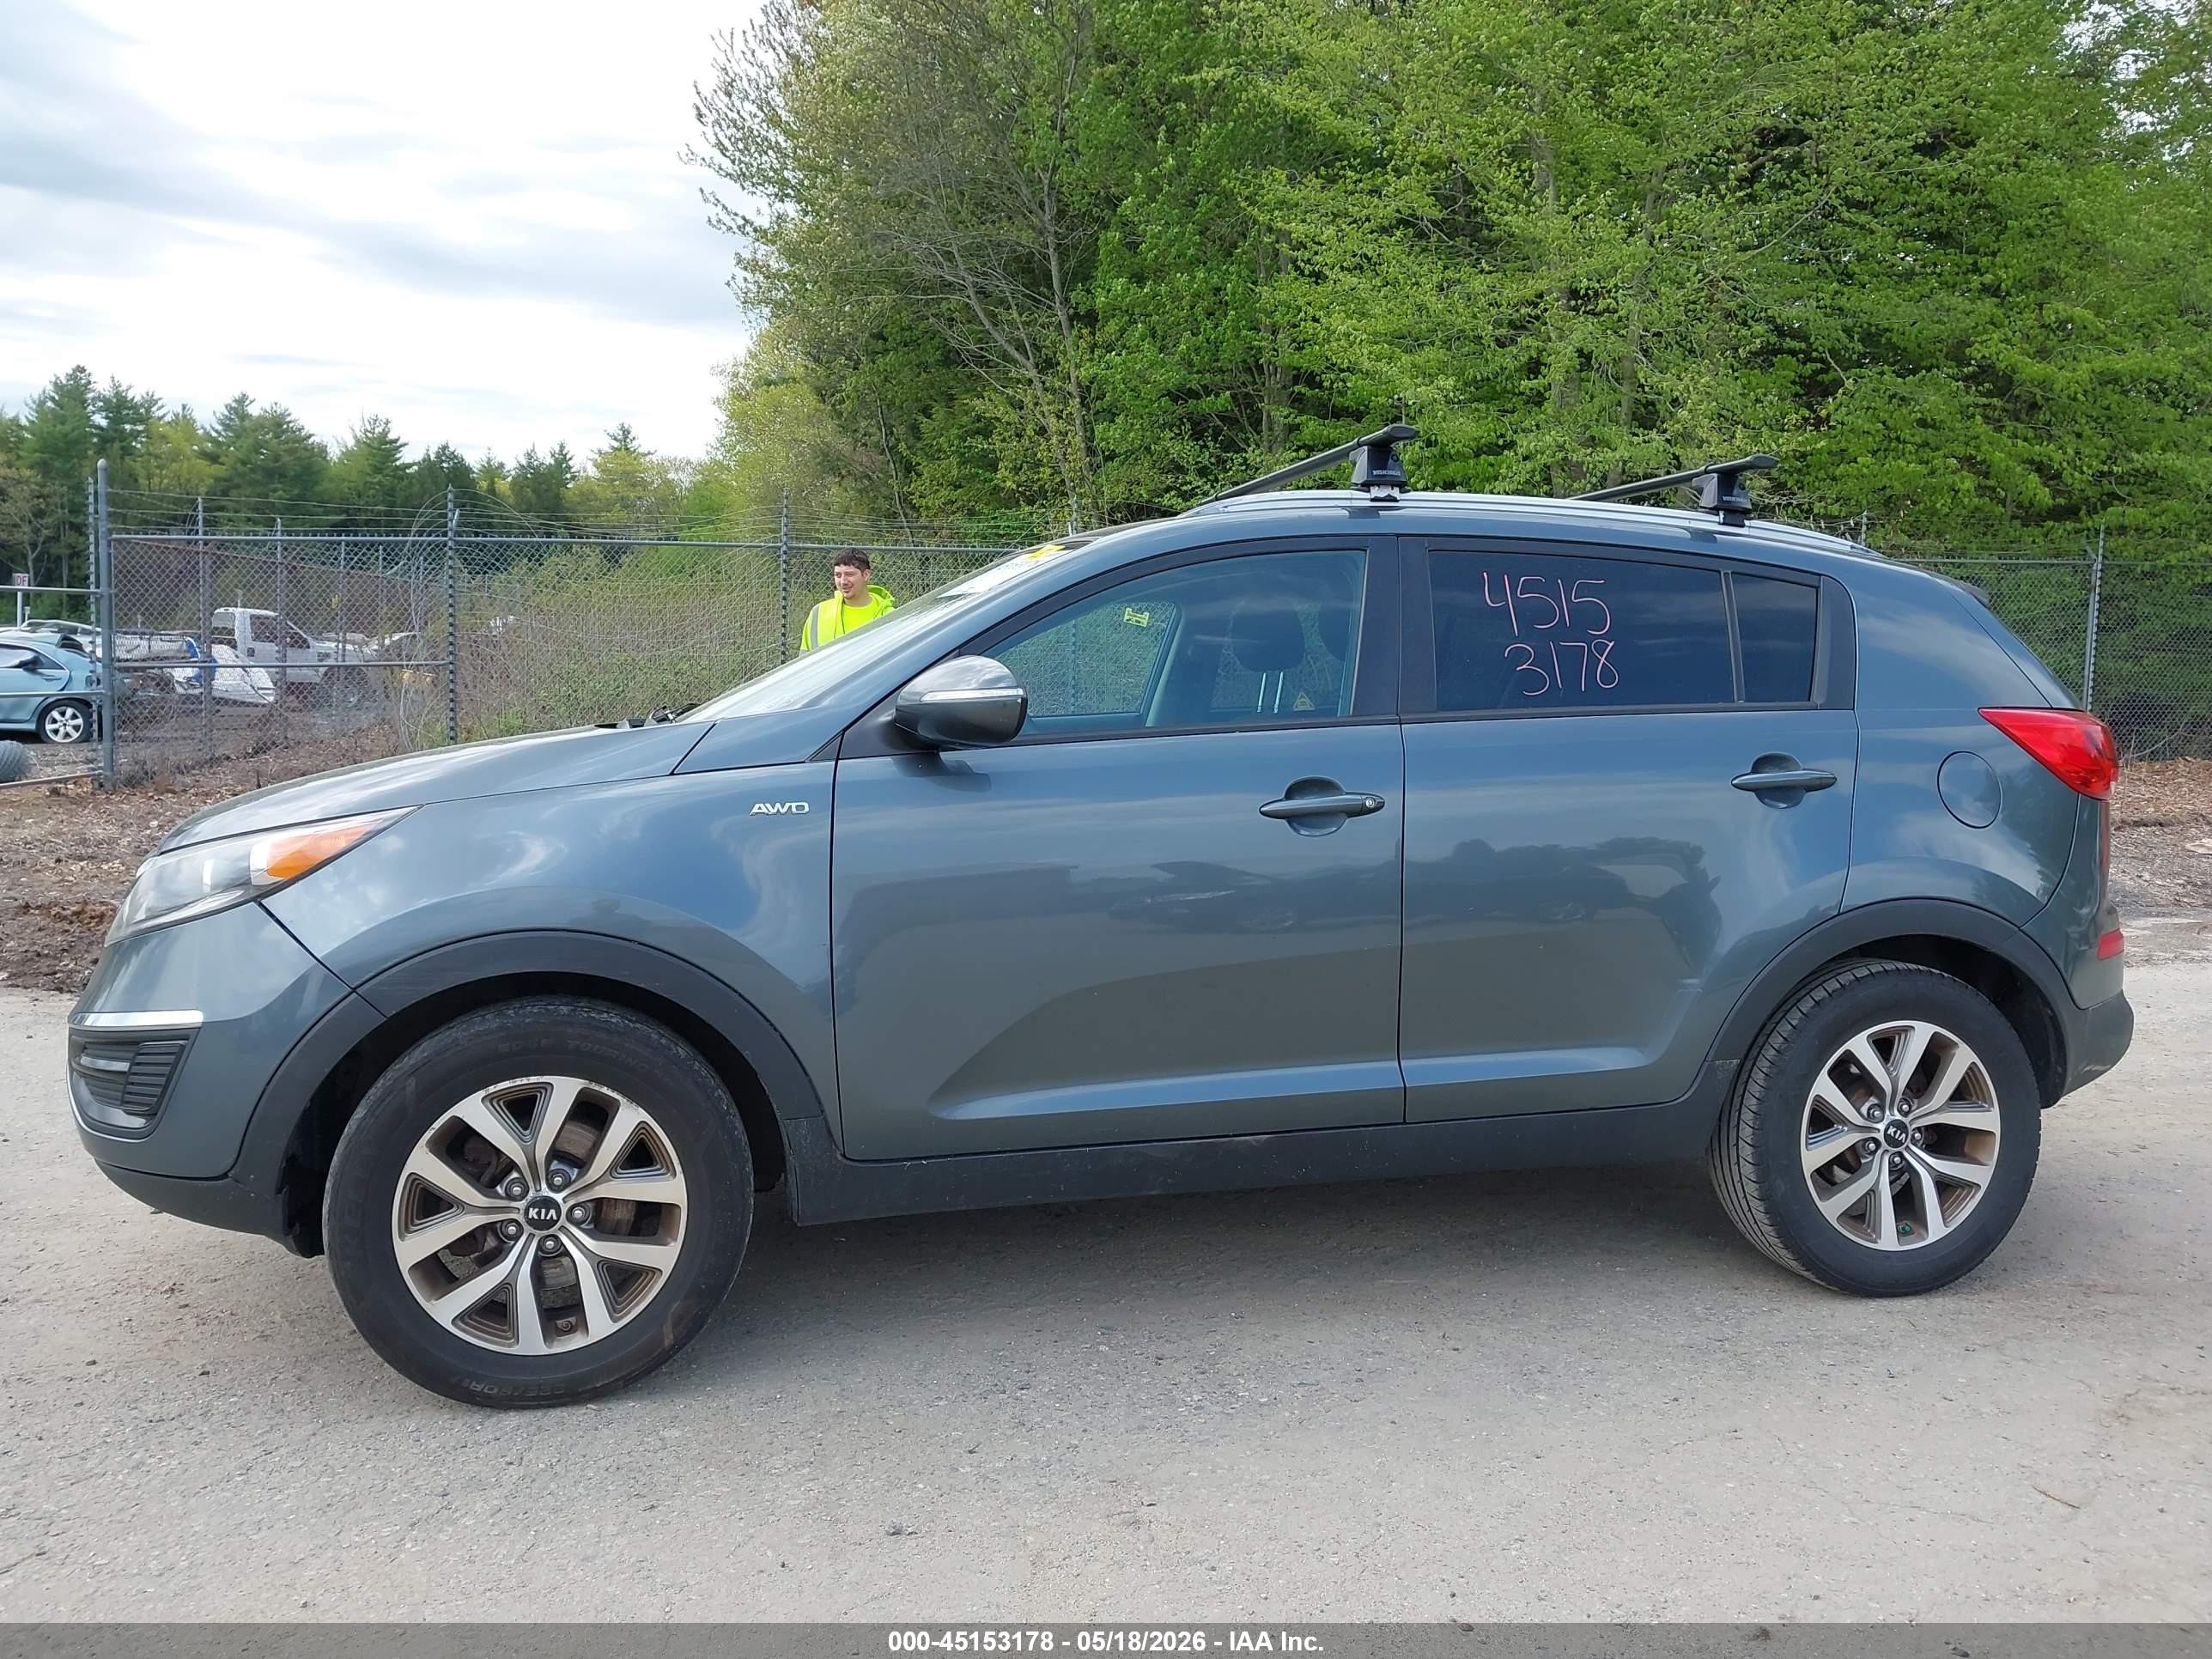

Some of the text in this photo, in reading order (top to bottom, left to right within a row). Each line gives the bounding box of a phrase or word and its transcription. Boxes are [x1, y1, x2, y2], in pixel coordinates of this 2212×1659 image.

[1483, 571, 1612, 636] 4515
[1504, 639, 1620, 696] 3178
[749, 801, 810, 816] AWD
[1887, 1125, 1905, 1144] KIA
[528, 1207, 557, 1220] KIA
